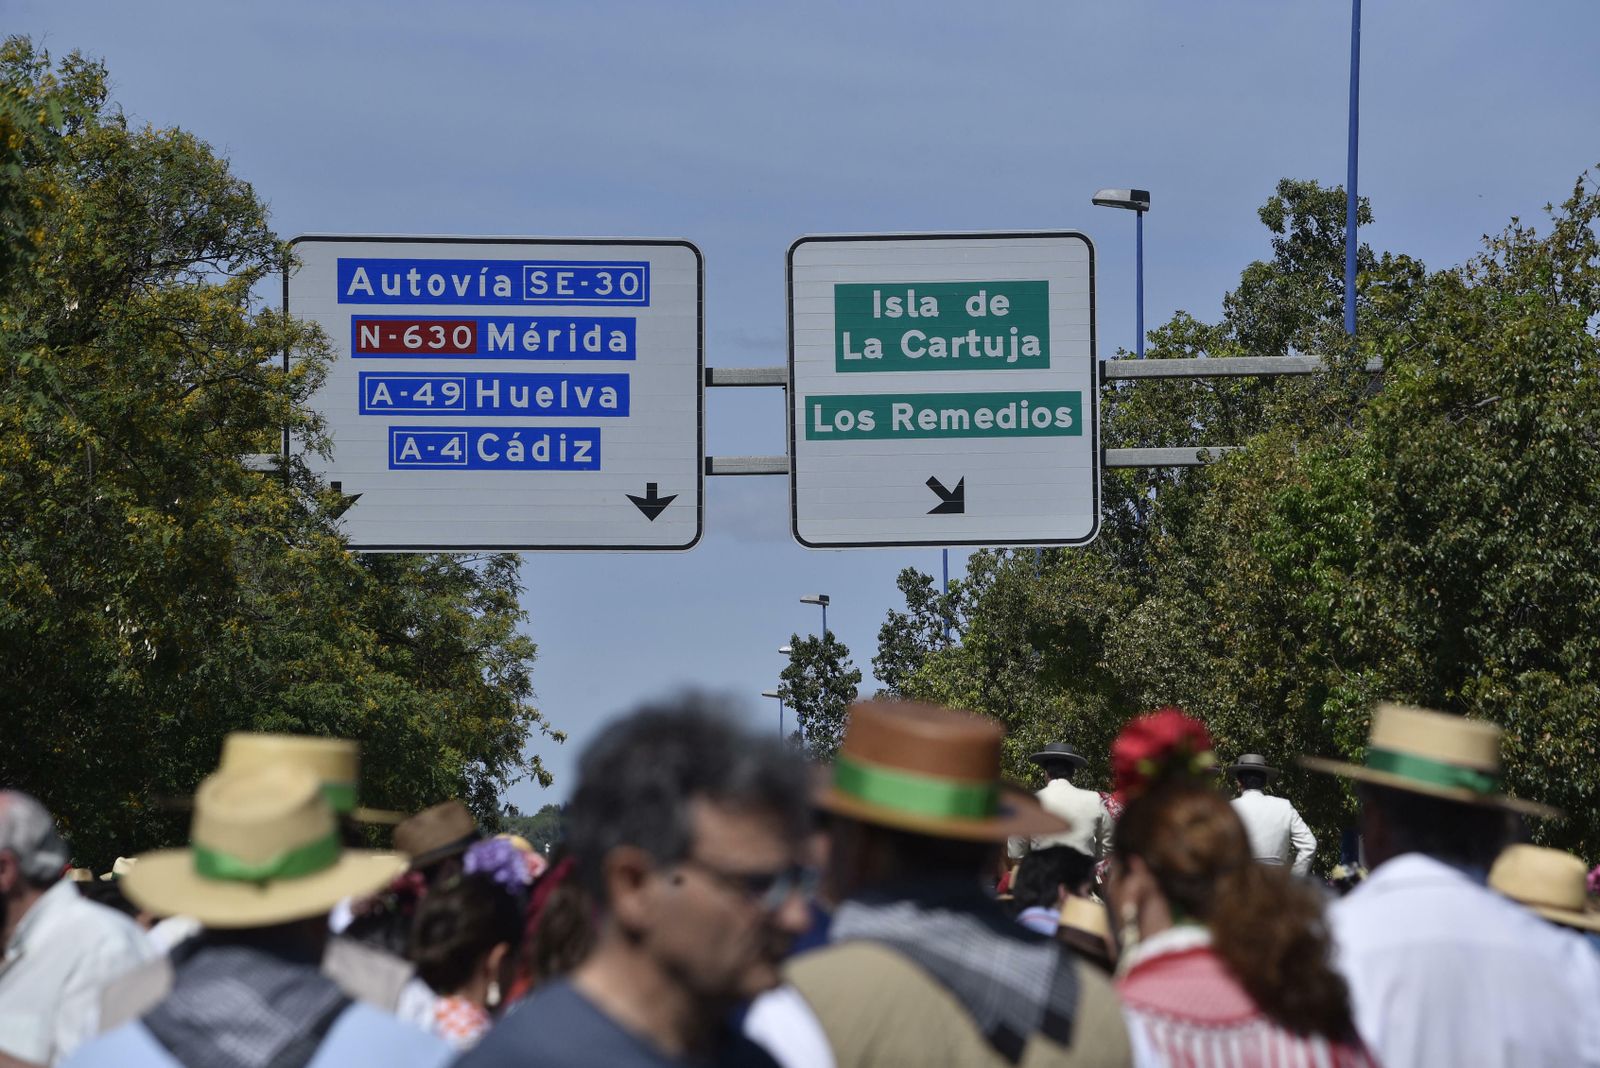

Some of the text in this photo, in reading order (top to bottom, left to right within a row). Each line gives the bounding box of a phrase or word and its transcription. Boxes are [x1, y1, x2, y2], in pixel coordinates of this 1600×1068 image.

[347, 266, 639, 297] Autovía SE-30
[873, 289, 1010, 318] Isla de
[360, 322, 627, 353] N-630 Mérida
[843, 326, 1041, 363] La Cartuja
[371, 379, 618, 409] A-49 Huelva
[814, 400, 1073, 433] Los Remedios
[400, 432, 592, 462] A-4 Cádiz
